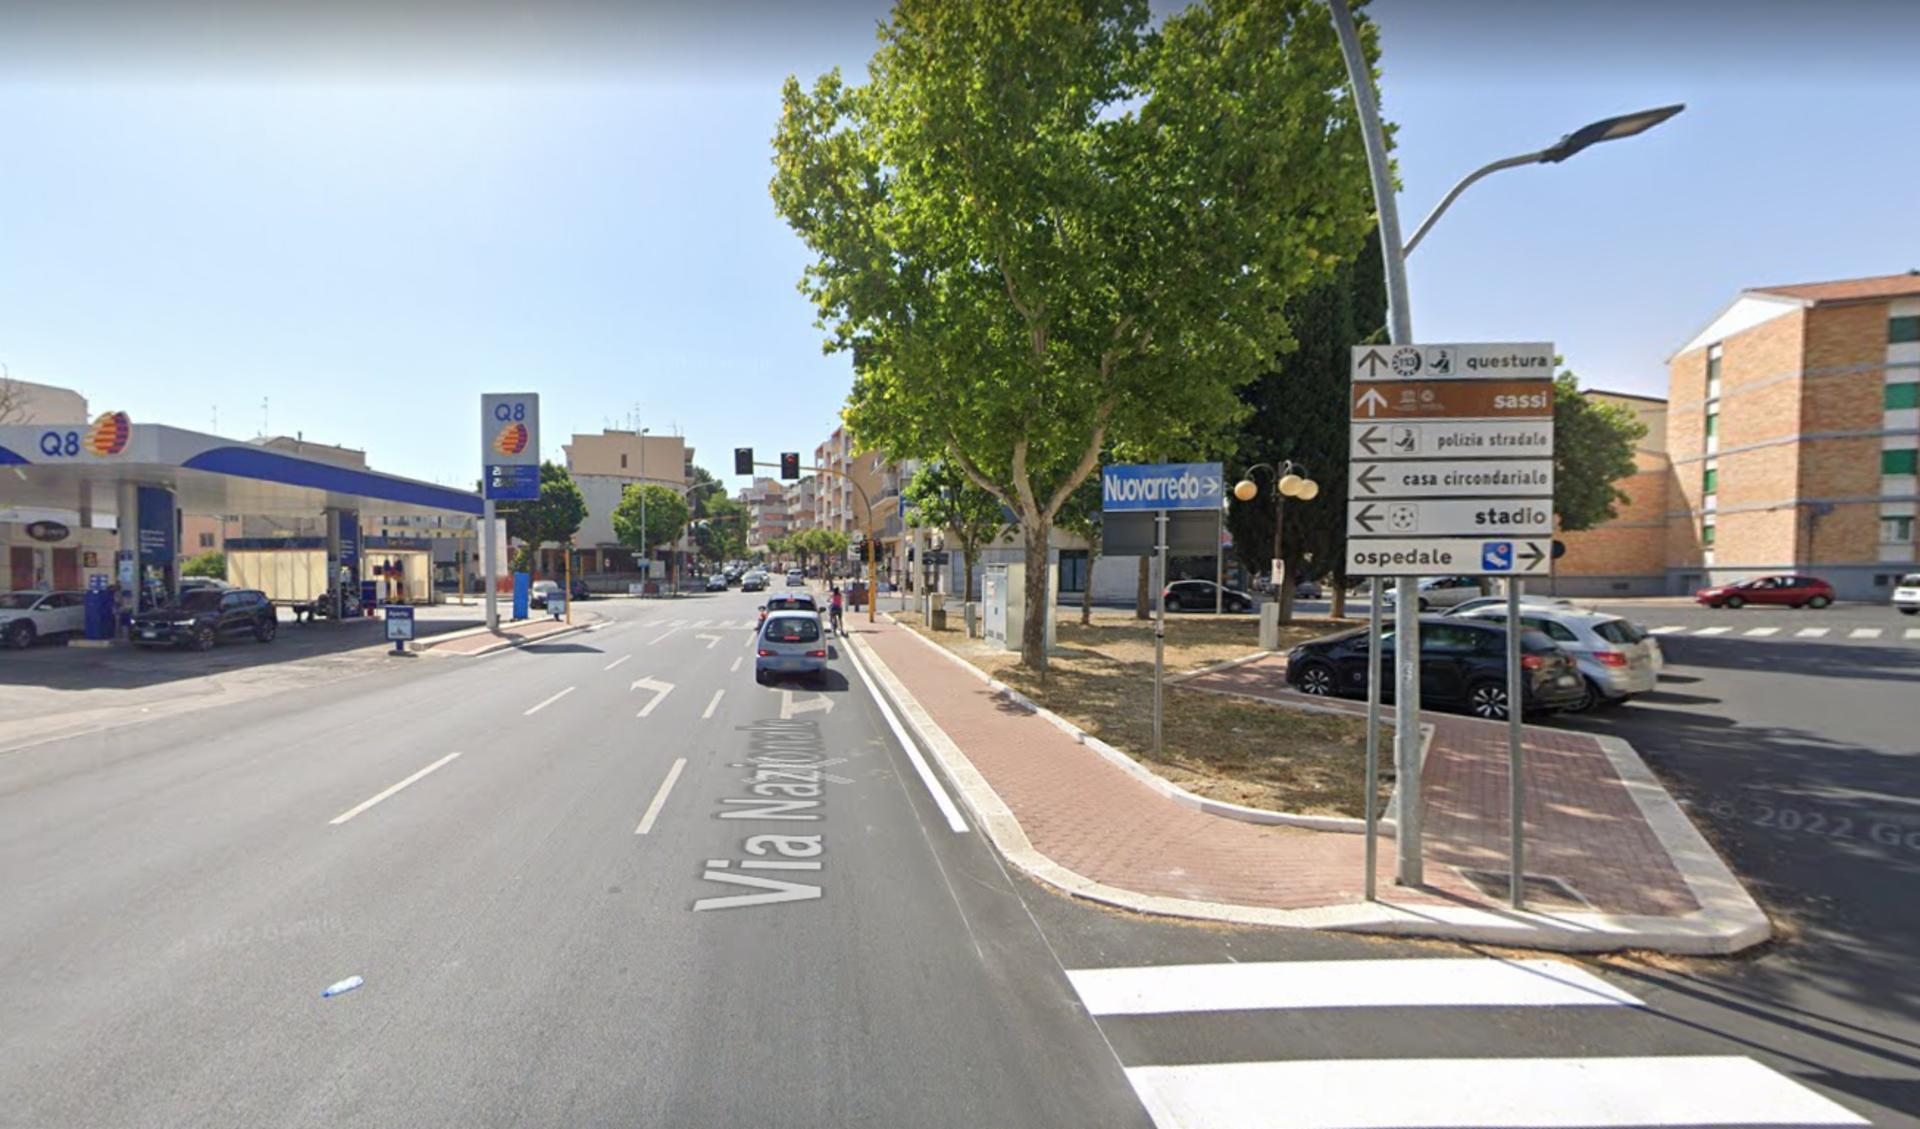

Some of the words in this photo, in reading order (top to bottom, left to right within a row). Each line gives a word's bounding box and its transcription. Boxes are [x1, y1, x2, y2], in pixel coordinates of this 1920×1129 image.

[1466, 353, 1548, 369] questura
[1493, 389, 1547, 408] sassi
[494, 403, 525, 422] Q8
[40, 431, 80, 457] Q8
[1438, 432, 1483, 449] polizia
[1489, 431, 1547, 446] stradale
[1403, 473, 1437, 486] casa
[1444, 469, 1547, 486] circondariale
[1103, 472, 1199, 502] Nuovarredo
[1475, 507, 1546, 525] stadio
[1353, 548, 1452, 566] ospedale
